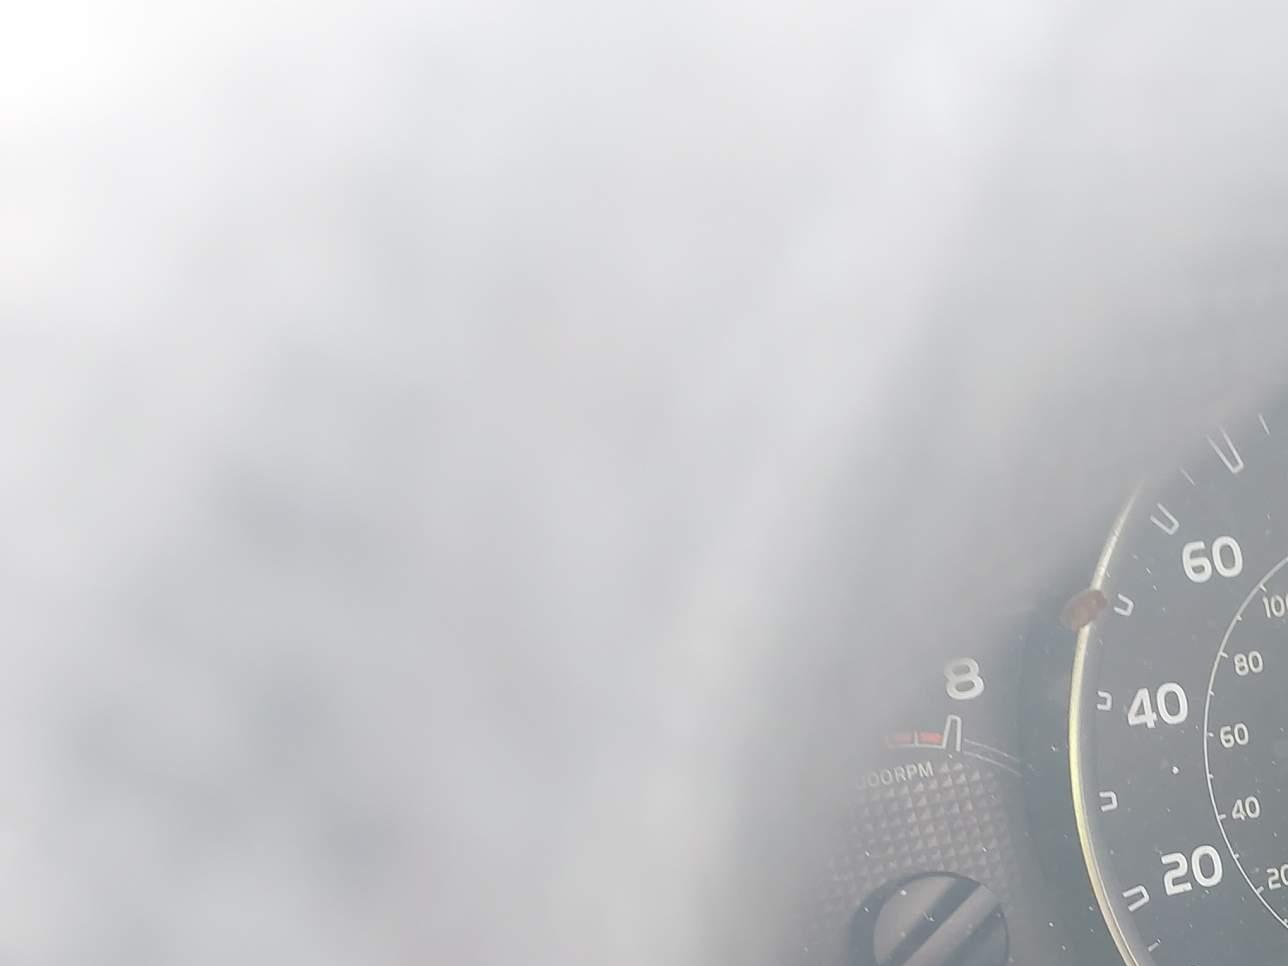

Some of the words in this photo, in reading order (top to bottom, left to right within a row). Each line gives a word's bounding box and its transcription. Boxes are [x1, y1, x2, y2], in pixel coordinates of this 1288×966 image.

[1181, 534, 1244, 584] 60
[943, 656, 985, 701] 8
[1232, 649, 1264, 676] 80
[1126, 681, 1189, 729] 40
[1219, 723, 1249, 749] 60
[1230, 796, 1261, 821] 40
[1161, 844, 1224, 896] 20
